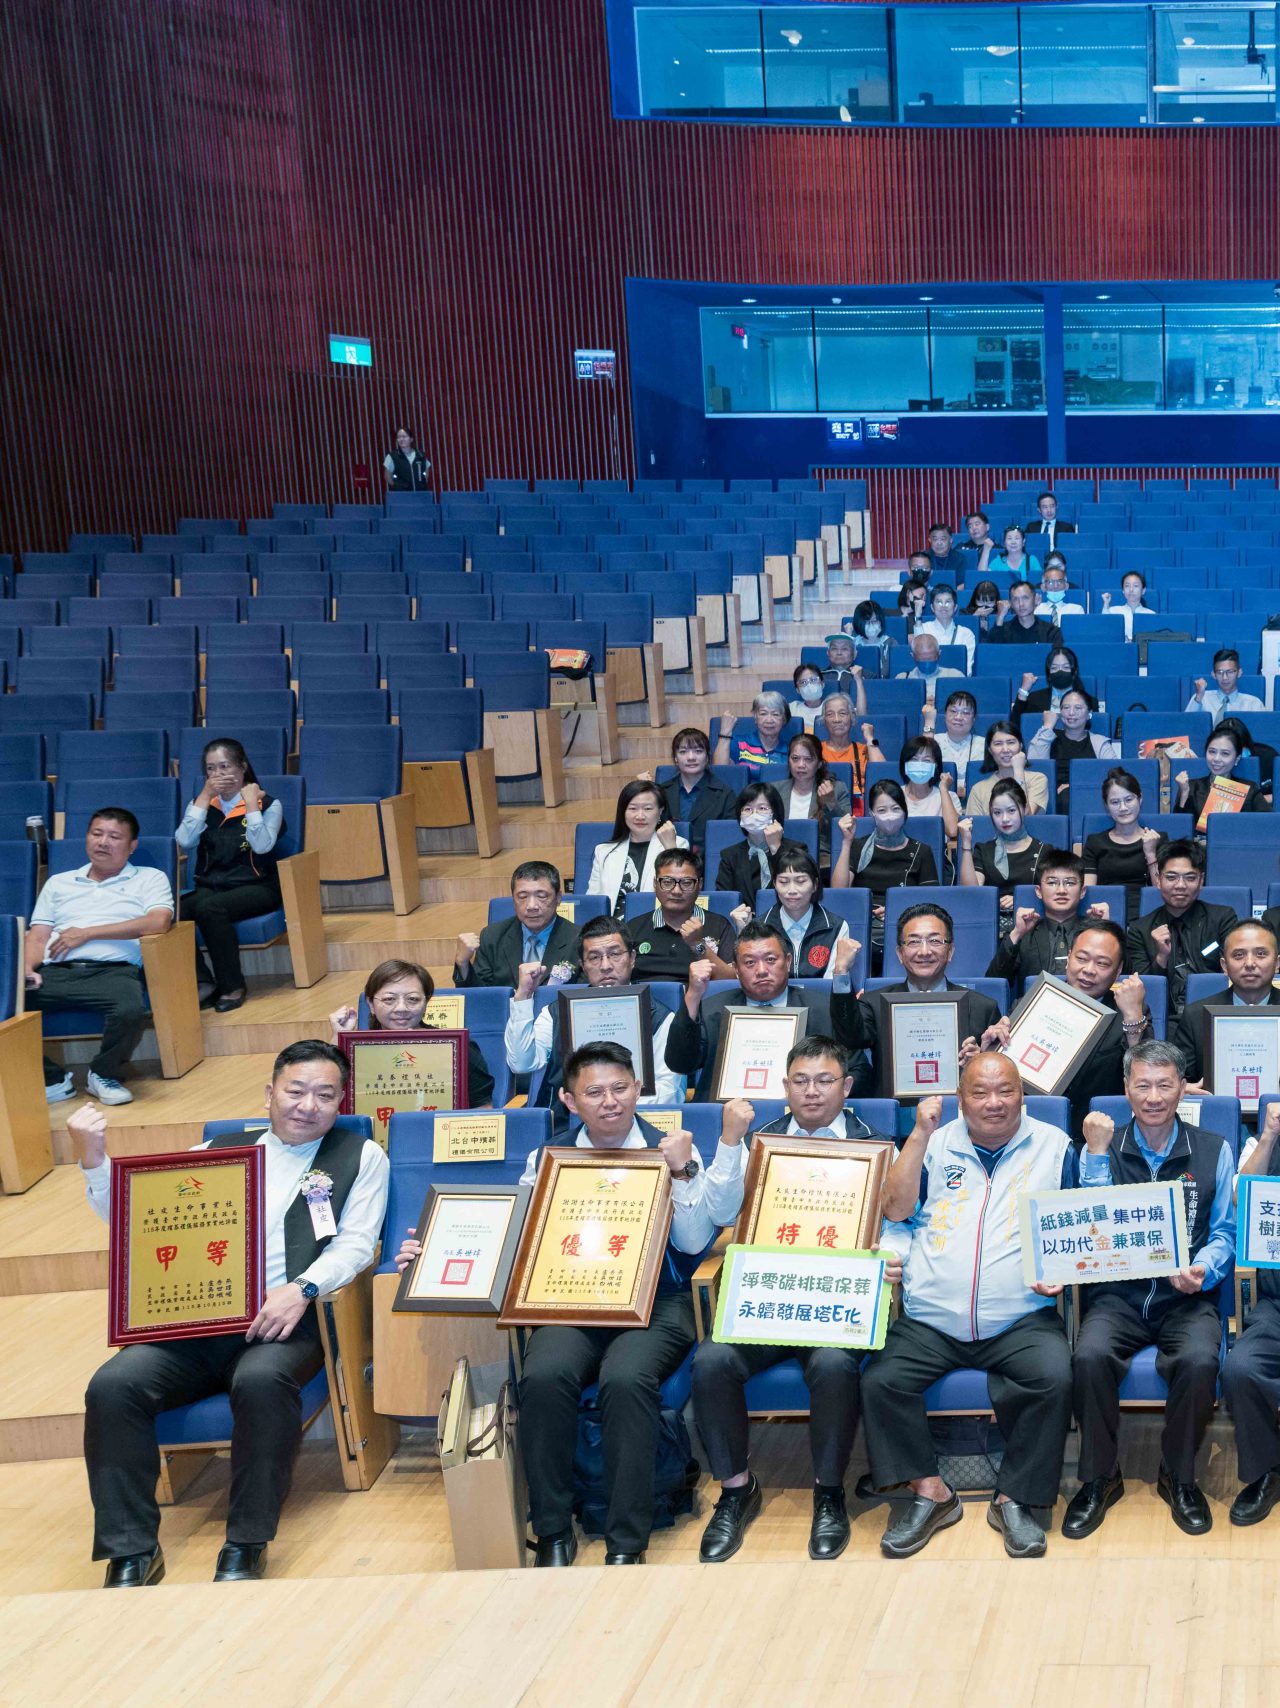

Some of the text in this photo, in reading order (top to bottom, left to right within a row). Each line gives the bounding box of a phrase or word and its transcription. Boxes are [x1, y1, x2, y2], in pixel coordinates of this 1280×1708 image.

[1039, 1203, 1166, 1232] 紙錢減量 集中燒
[560, 1233, 630, 1258] 優等
[776, 1222, 839, 1249] 特優
[1041, 1229, 1165, 1257] 以功代金兼環保
[155, 1239, 229, 1273] 甲等
[741, 1271, 872, 1296] 淨零碳排環保葬
[738, 1300, 862, 1326] 永續發展塔E化
